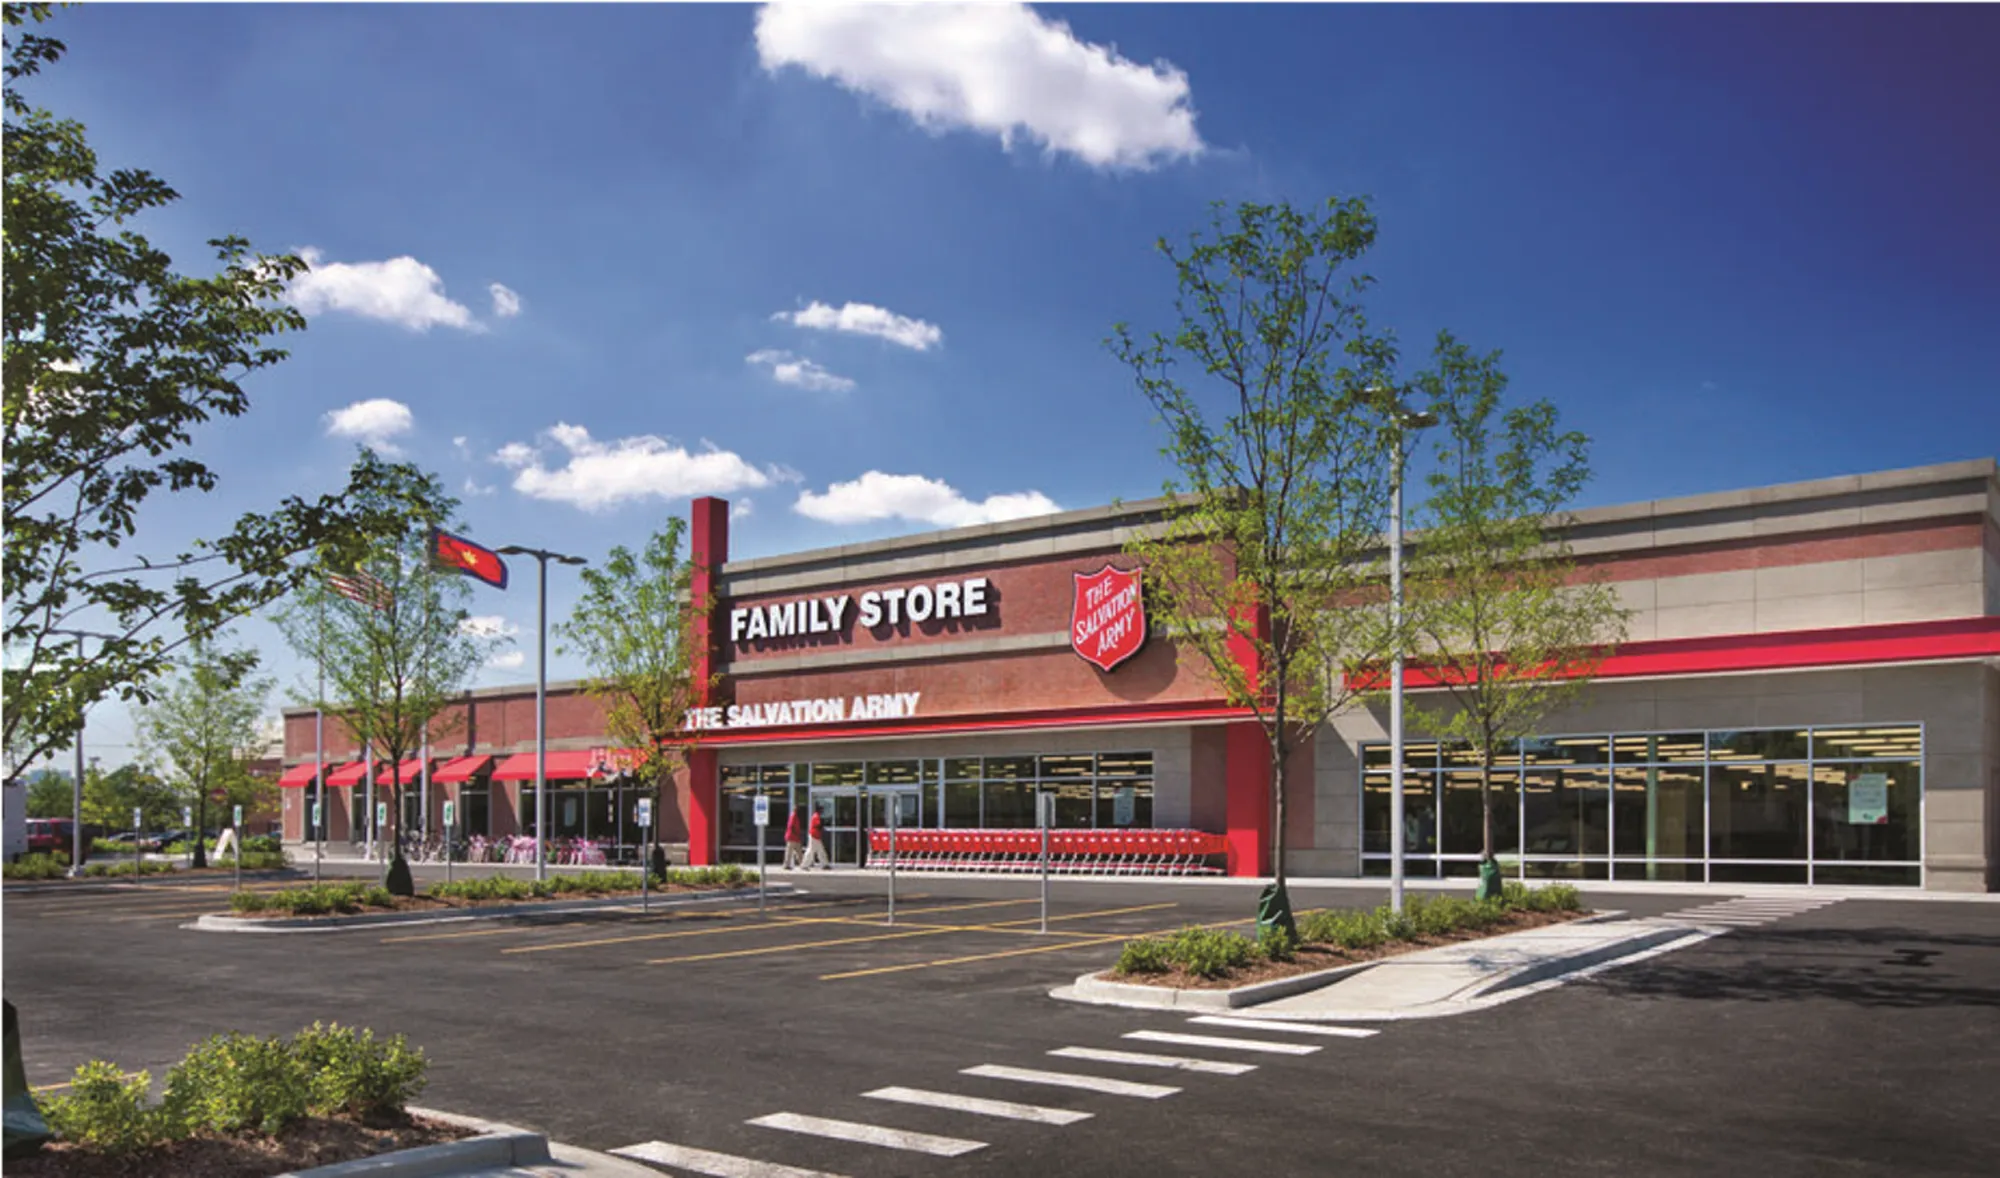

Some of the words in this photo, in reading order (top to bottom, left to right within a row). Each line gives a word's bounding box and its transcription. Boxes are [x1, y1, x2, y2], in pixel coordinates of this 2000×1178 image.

[730, 595, 849, 642] FAMILY
[859, 578, 988, 627] STORE
[1076, 583, 1136, 645] SALVATION
[1085, 575, 1112, 610] THE
[1096, 606, 1136, 657] ARMY
[683, 707, 724, 730] THE
[726, 697, 844, 726] SALVATION
[850, 692, 920, 720] ARMY
